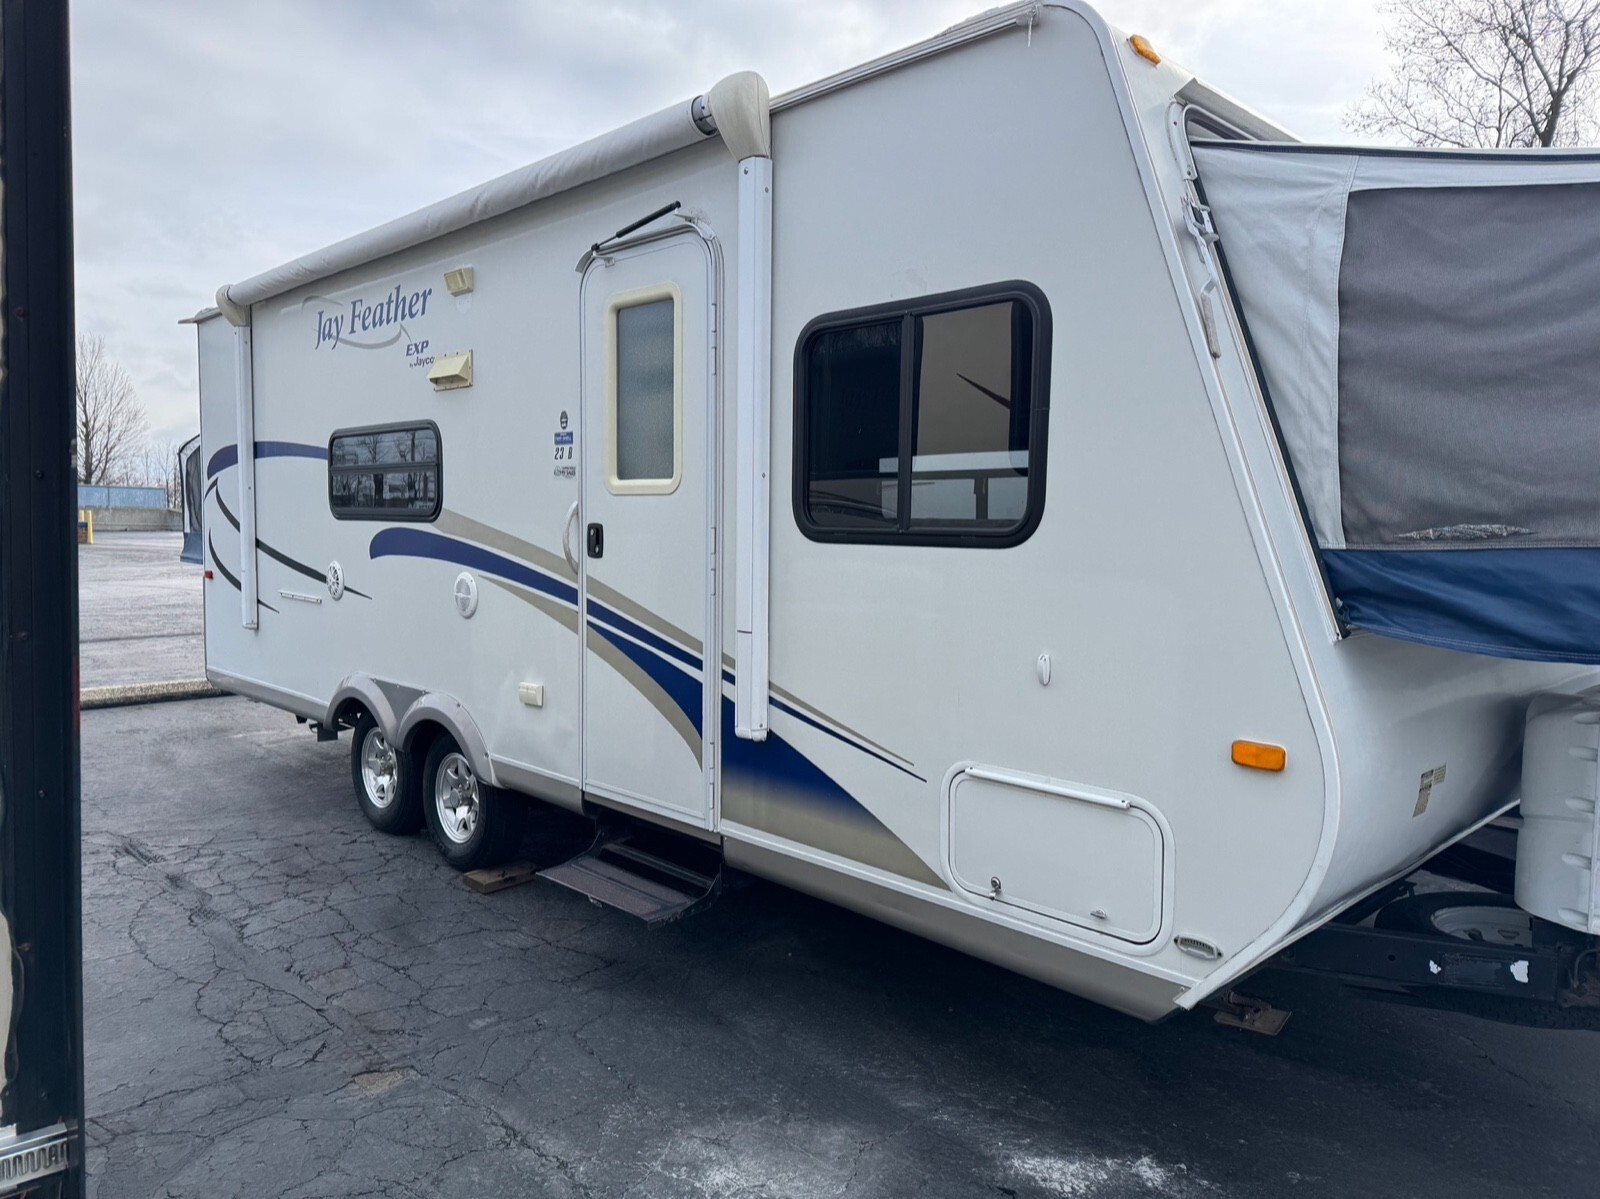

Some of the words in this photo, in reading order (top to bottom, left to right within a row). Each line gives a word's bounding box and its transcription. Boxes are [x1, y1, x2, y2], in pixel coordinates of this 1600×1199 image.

[315, 310, 344, 350] Jay
[349, 284, 433, 336] Feather
[406, 340, 429, 356] EXP
[414, 356, 435, 368] Jayco
[554, 446, 565, 460] 23
